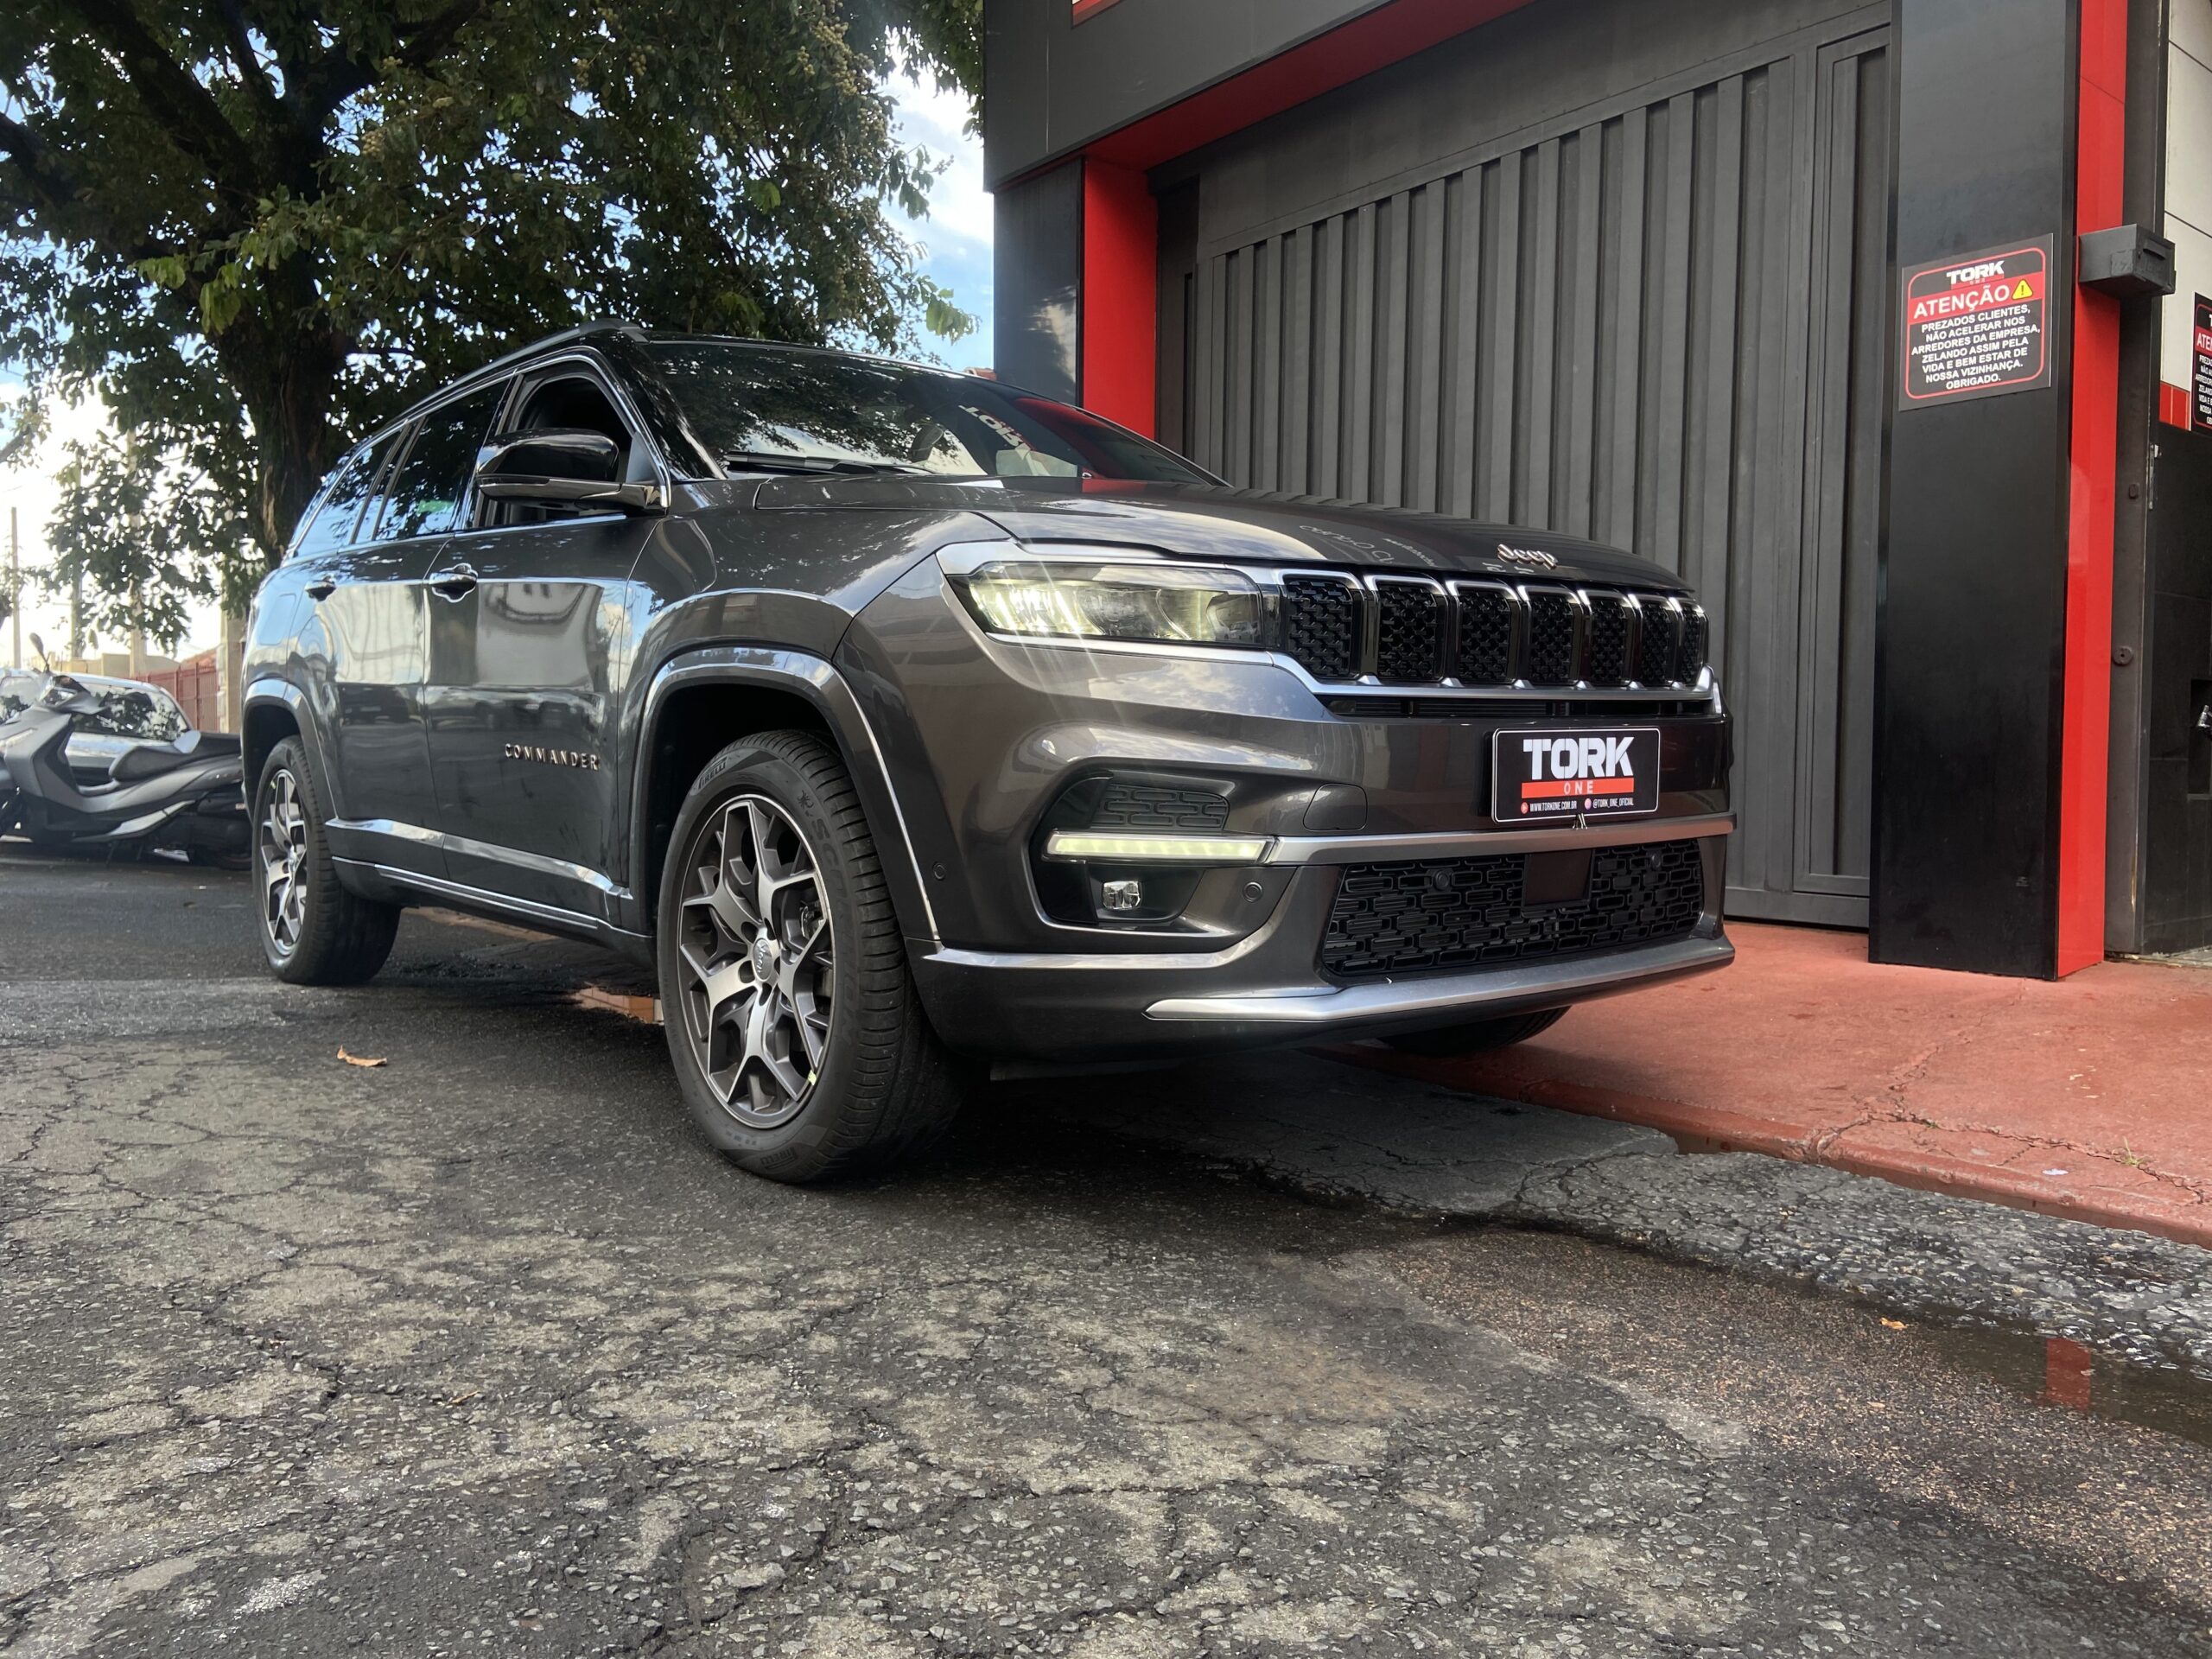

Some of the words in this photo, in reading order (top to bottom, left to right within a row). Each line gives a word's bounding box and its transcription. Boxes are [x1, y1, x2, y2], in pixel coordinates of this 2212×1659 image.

[1946, 260, 2005, 285] TORK
[1914, 283, 2009, 319] ATENÇÃO
[1921, 315, 1975, 333] PREZADOS
[1978, 304, 2031, 321] CLIENTES,
[1925, 330, 1947, 343] NÃO
[1948, 321, 2002, 338] ACELERAR
[2004, 315, 2025, 327] NOS
[1911, 336, 1971, 356] ARREDORES
[1973, 334, 1987, 343] DA
[1989, 324, 2040, 340] EMPRESA,
[1922, 347, 1967, 364] ZELANDO
[1969, 341, 1999, 354] ASSIM
[2002, 336, 2029, 349] PELA
[1922, 362, 1945, 374] VIDA
[1947, 361, 1953, 370] E
[1955, 356, 1976, 368] BEM
[1979, 351, 2011, 363] ESTAR
[2013, 347, 2028, 357] DE
[1925, 370, 1959, 384] NOSSA
[1961, 359, 2023, 377] VIZINHANÇA.
[1946, 373, 2001, 390] OBRIGADO.
[505, 743, 600, 771] COMMANDER
[1523, 737, 1635, 780] TORK
[1564, 780, 1593, 795] ONE
